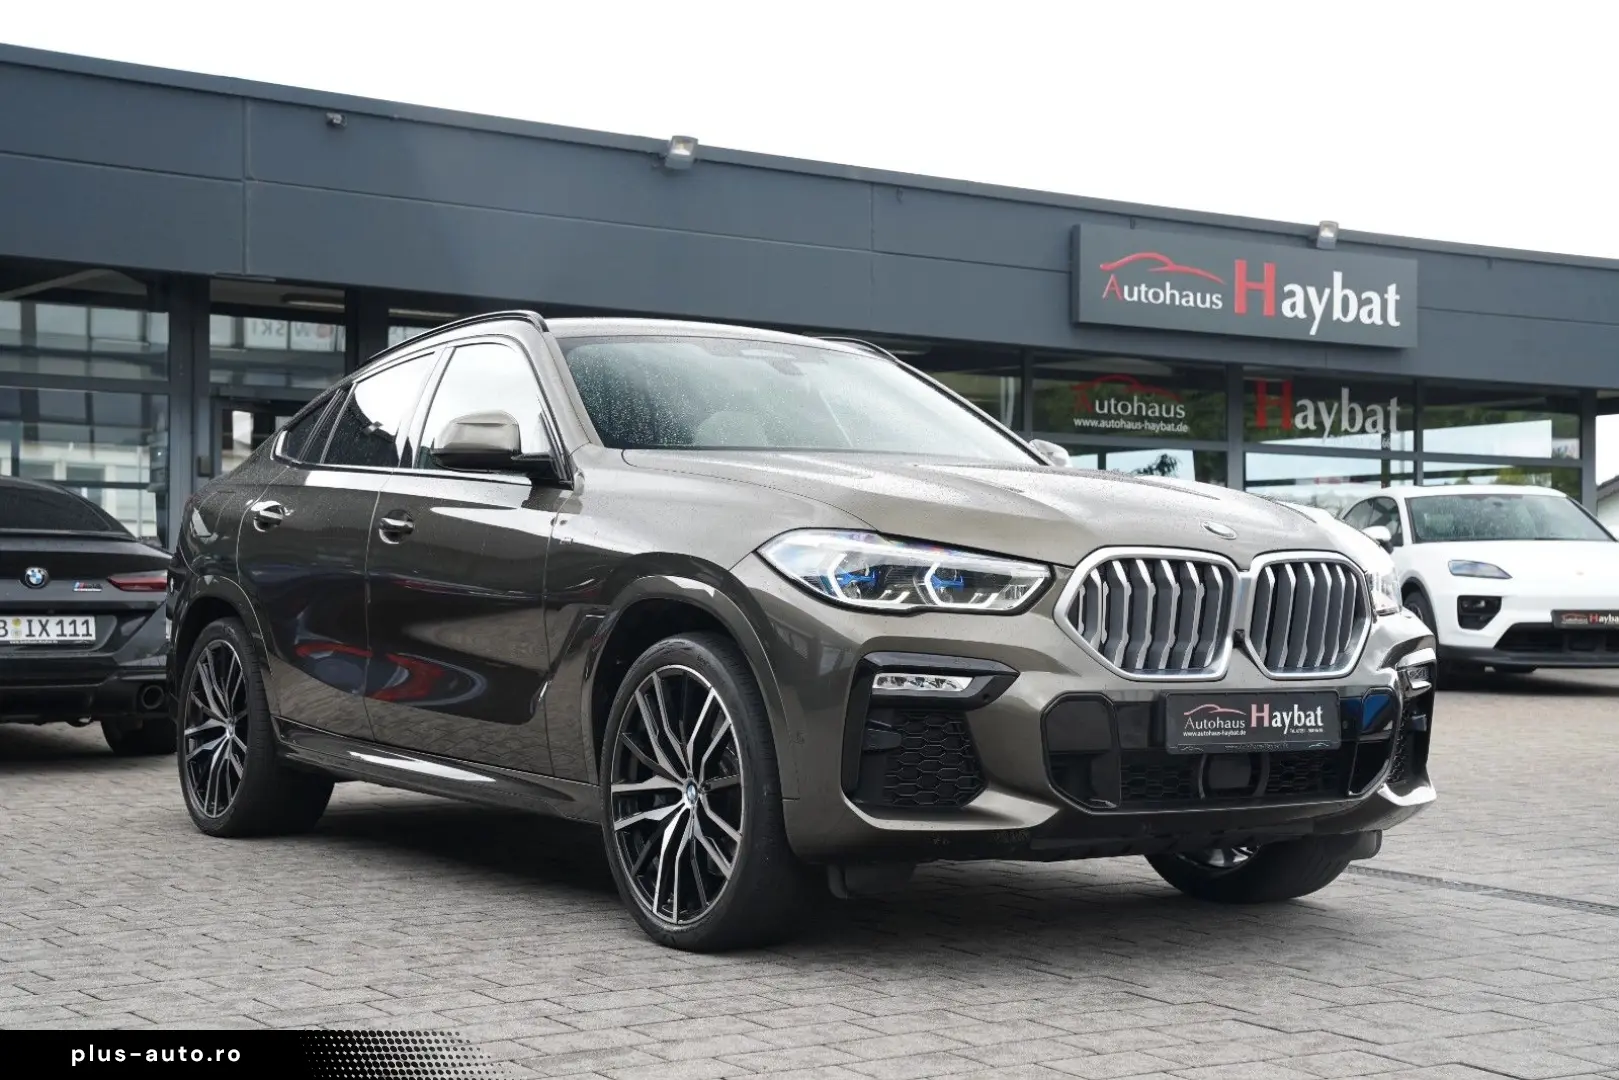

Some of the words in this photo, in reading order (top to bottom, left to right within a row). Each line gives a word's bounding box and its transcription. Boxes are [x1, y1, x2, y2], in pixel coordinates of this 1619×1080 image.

[1102, 273, 1223, 310] Autohaus
[1233, 258, 1401, 336] Haybat
[1073, 418, 1189, 433] www.autohaus-haybat.de
[1075, 392, 1186, 419] Autohaus
[1255, 379, 1403, 443] Haybat
[26, 619, 51, 637] IX
[56, 619, 93, 637] 111
[1184, 717, 1246, 729] Autohaus
[1250, 703, 1324, 735] Haybat
